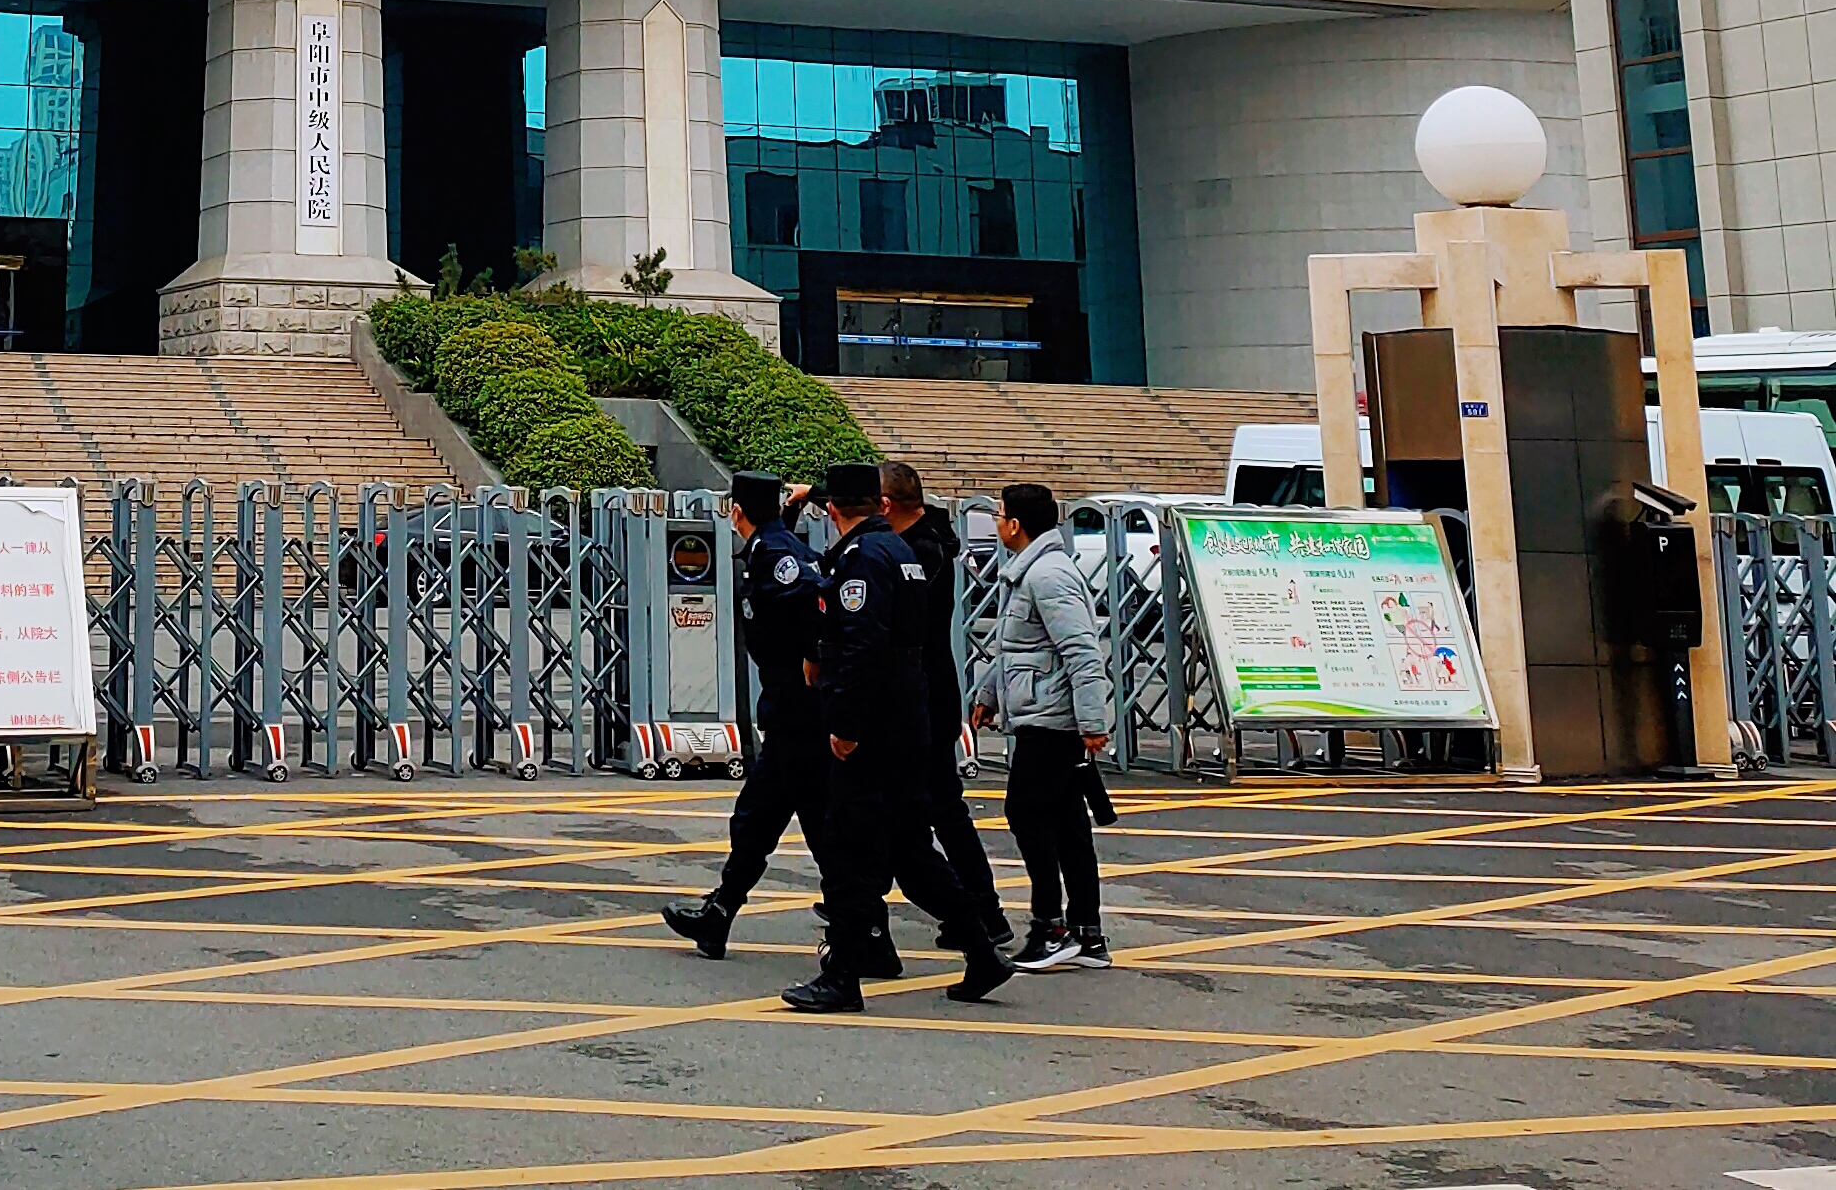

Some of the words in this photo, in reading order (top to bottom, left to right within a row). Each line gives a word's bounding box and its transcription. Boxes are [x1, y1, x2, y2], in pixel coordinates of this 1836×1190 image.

[307, 21, 331, 221] 阜阳市中级人民法院
[1658, 536, 1669, 552] P
